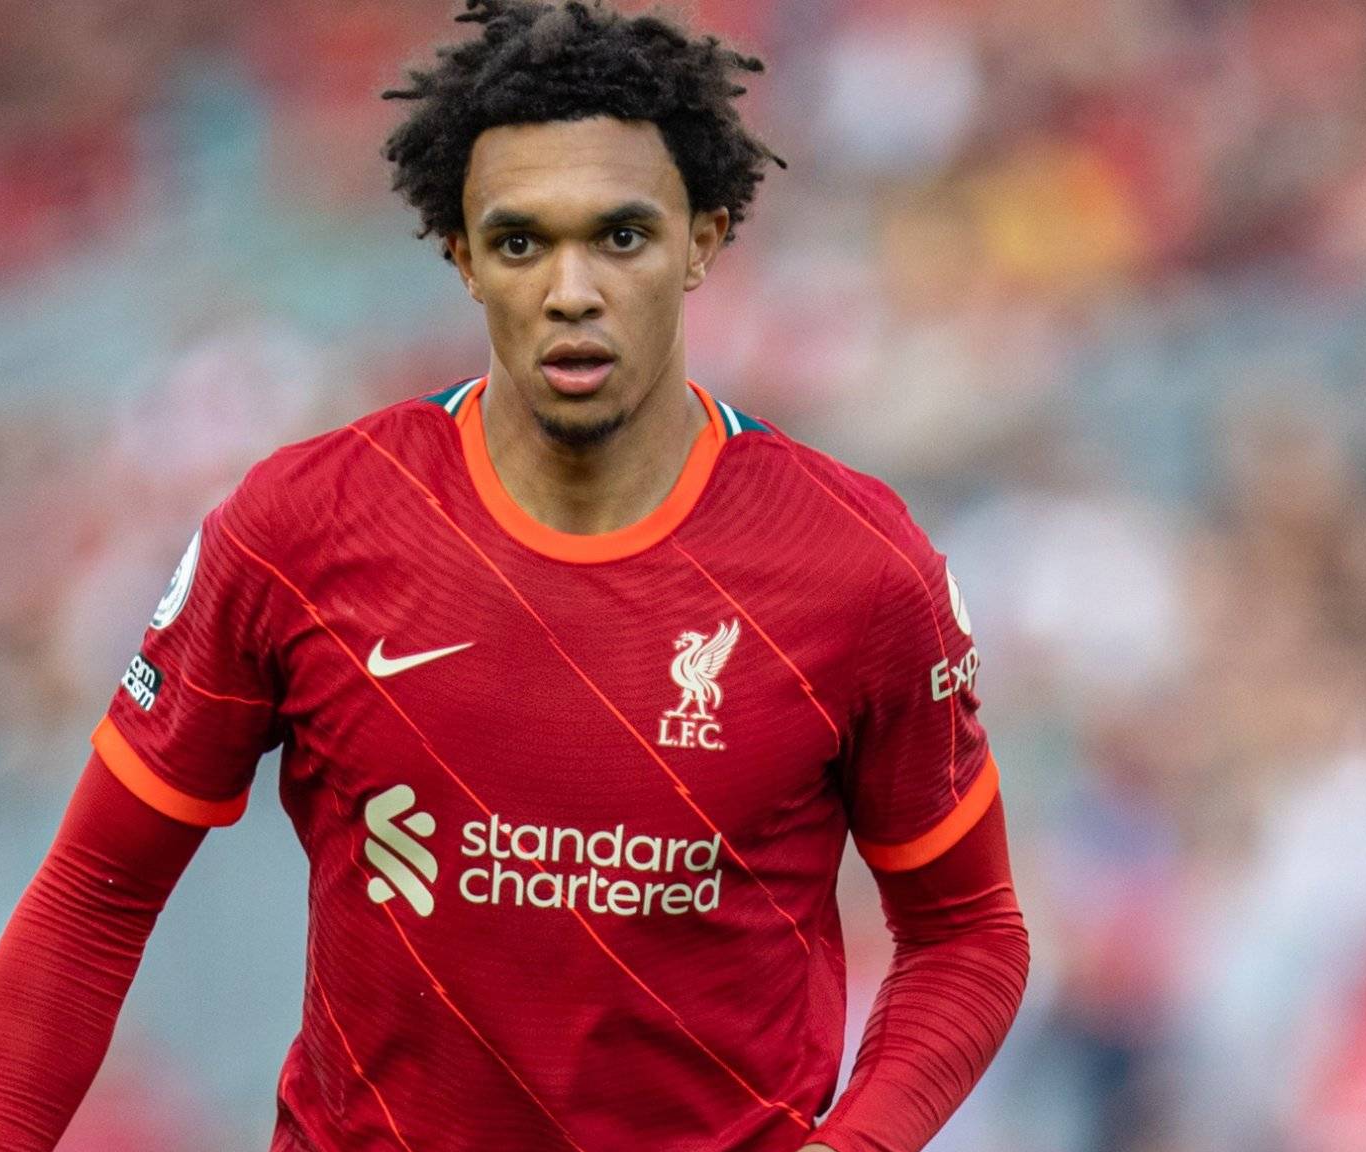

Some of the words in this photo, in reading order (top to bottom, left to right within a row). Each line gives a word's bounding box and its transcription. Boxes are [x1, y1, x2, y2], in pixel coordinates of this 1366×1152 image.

[657, 719, 727, 751] L.F.C.
[461, 813, 722, 873] standard
[459, 860, 723, 916] chartered
